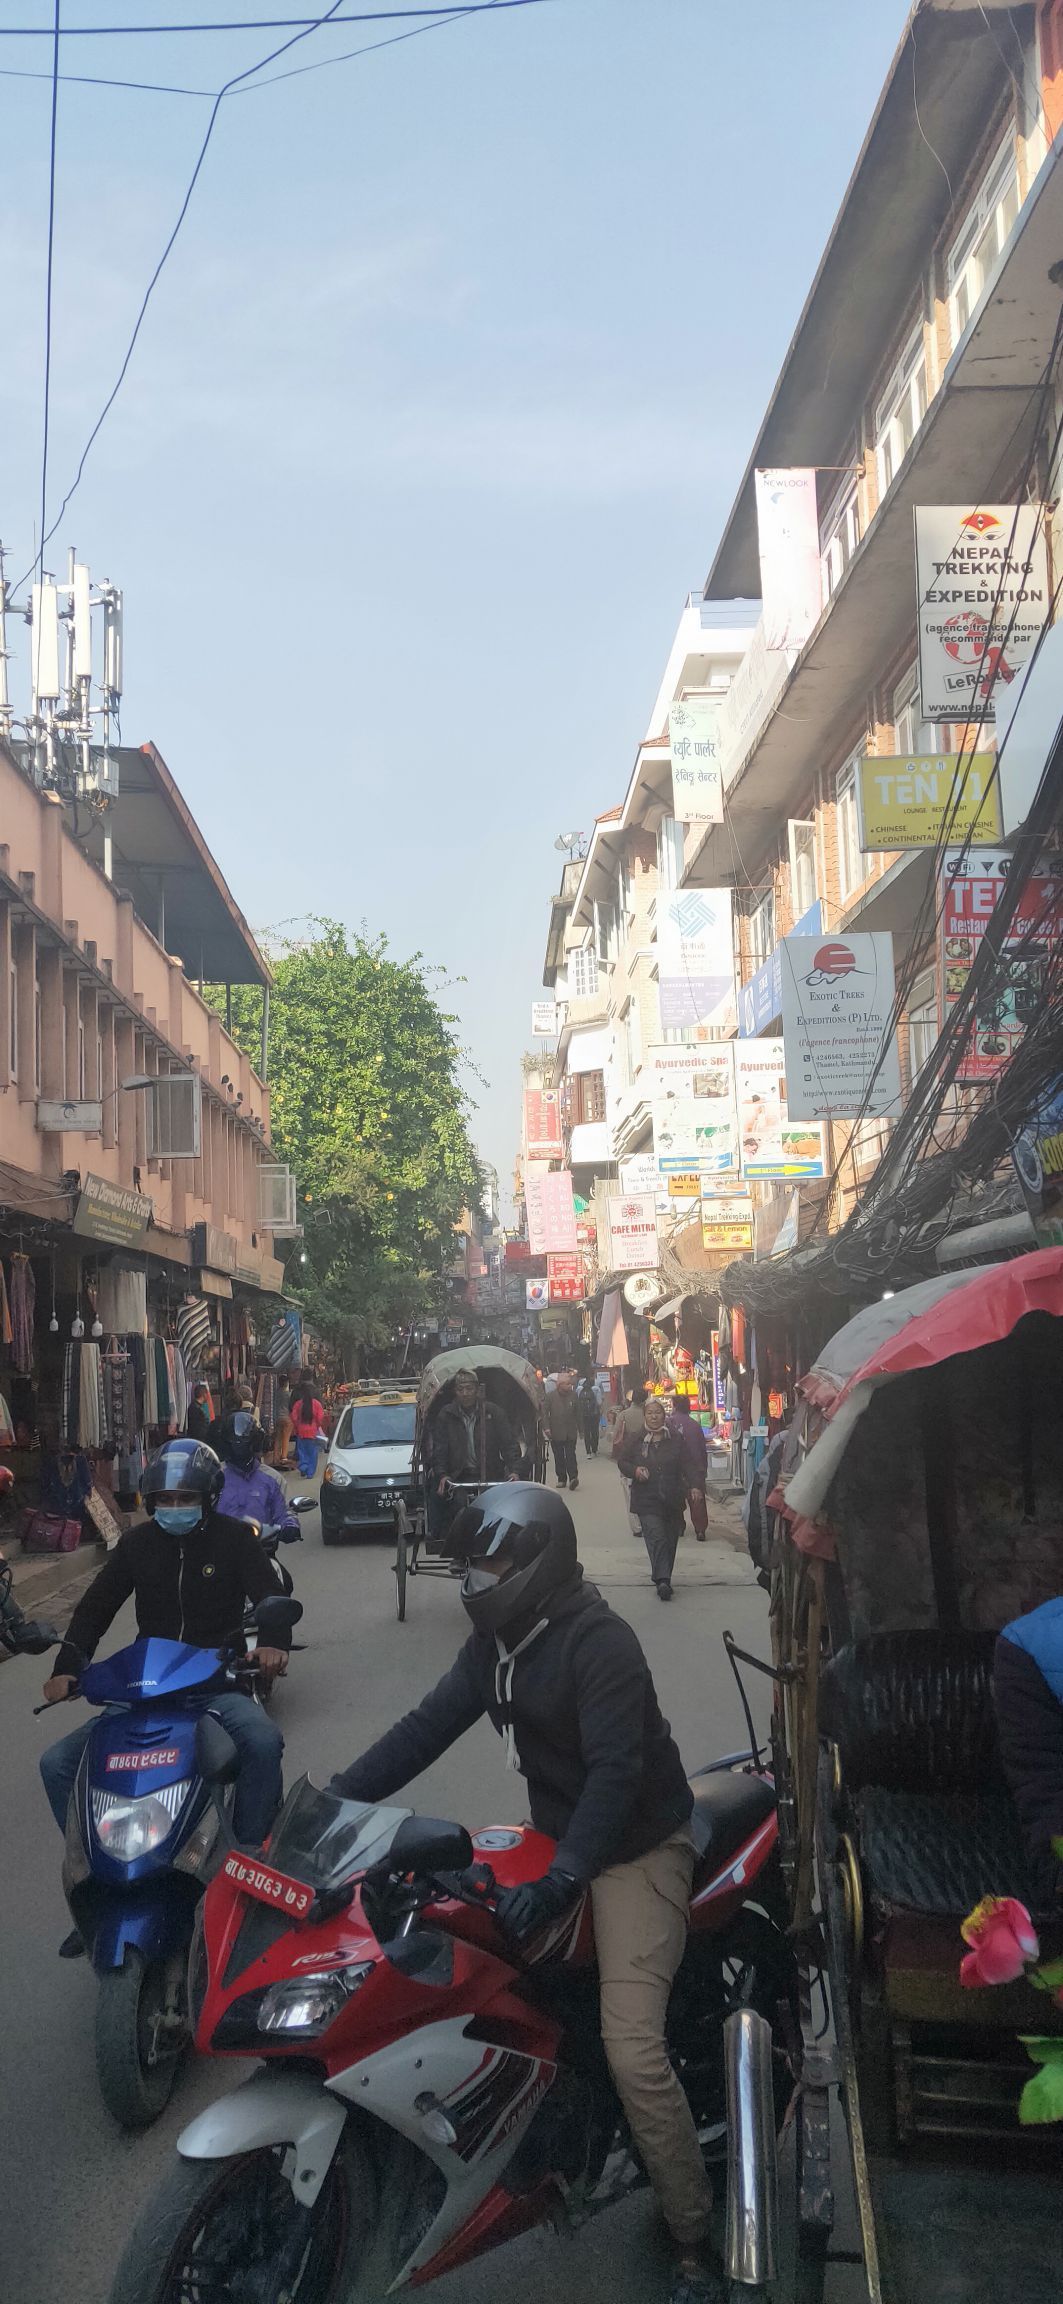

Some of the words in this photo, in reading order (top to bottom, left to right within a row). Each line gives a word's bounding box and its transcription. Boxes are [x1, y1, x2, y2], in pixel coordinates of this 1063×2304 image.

[952, 548, 1013, 559] NEPAL
[932, 562, 1034, 574] TREKKING
[980, 579, 988, 587] &
[926, 590, 1043, 602] EXPEDITION
[926, 624, 969, 633] (agence
[973, 624, 1043, 633] fracohone)
[940, 634, 1010, 642] recommnd
[1014, 635, 1031, 643] par
[875, 774, 938, 804] TEN
[964, 821, 993, 829] CUSINE
[883, 834, 936, 843] CONTINENTAL
[810, 991, 837, 1000] EXOTIC
[839, 990, 865, 999] TREKS
[832, 1004, 840, 1012] &
[797, 1016, 846, 1025] EXPEDITIONS
[849, 1013, 861, 1023] (P)
[864, 1013, 882, 1021] LTD.
[655, 1058, 708, 1069] Ayurvedic
[611, 1225, 630, 1235] CAFE
[632, 1223, 656, 1233] MITRA
[127, 1680, 158, 1688] HONDA
